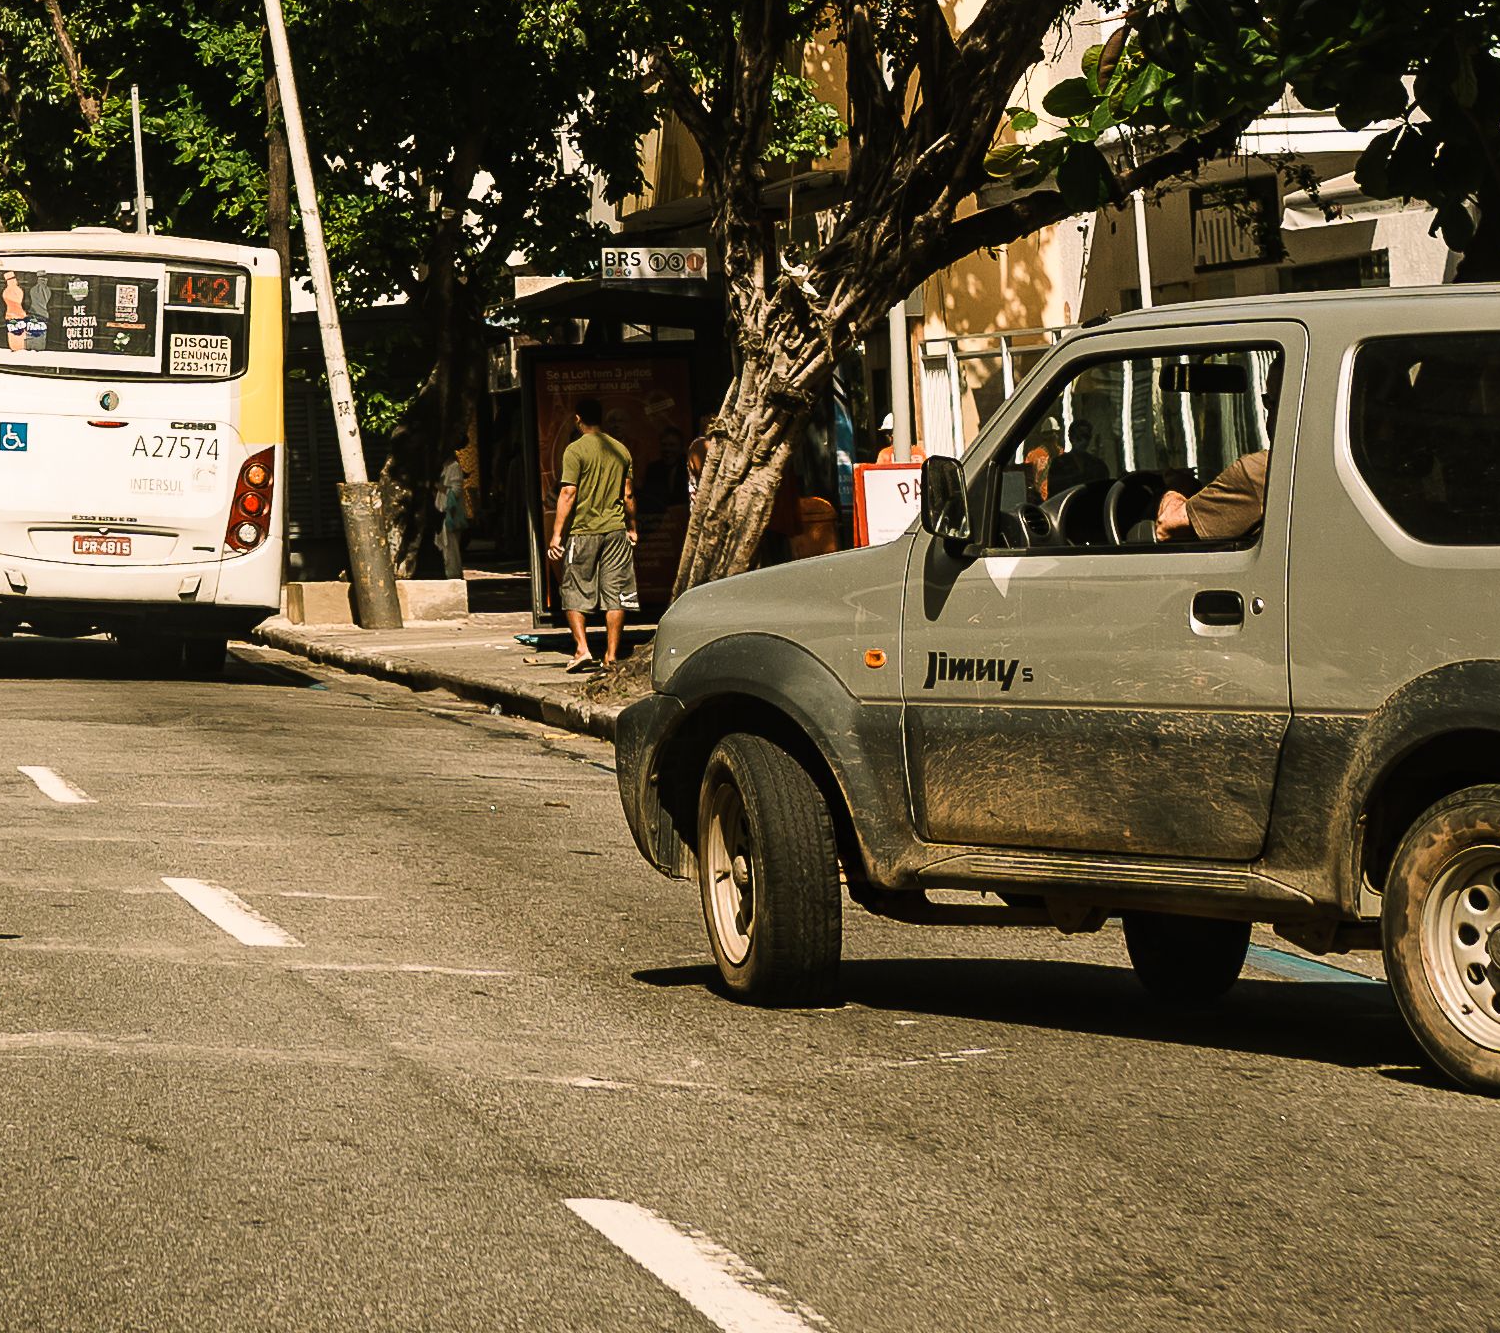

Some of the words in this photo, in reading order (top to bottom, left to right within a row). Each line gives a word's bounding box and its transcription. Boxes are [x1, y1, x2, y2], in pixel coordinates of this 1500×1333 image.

[604, 251, 642, 267] BRS
[73, 305, 87, 316] ME
[62, 316, 98, 328] ASSUSTA
[66, 327, 82, 339] QUE
[83, 327, 94, 338] EU
[67, 339, 94, 350] GOSTO
[174, 336, 229, 350] DISQUE
[173, 350, 228, 362] DENÚNCIA
[173, 361, 228, 373] 2253-1177
[131, 435, 220, 462] A27574
[130, 478, 184, 493] INTERSUL
[922, 651, 1020, 692] Jimny
